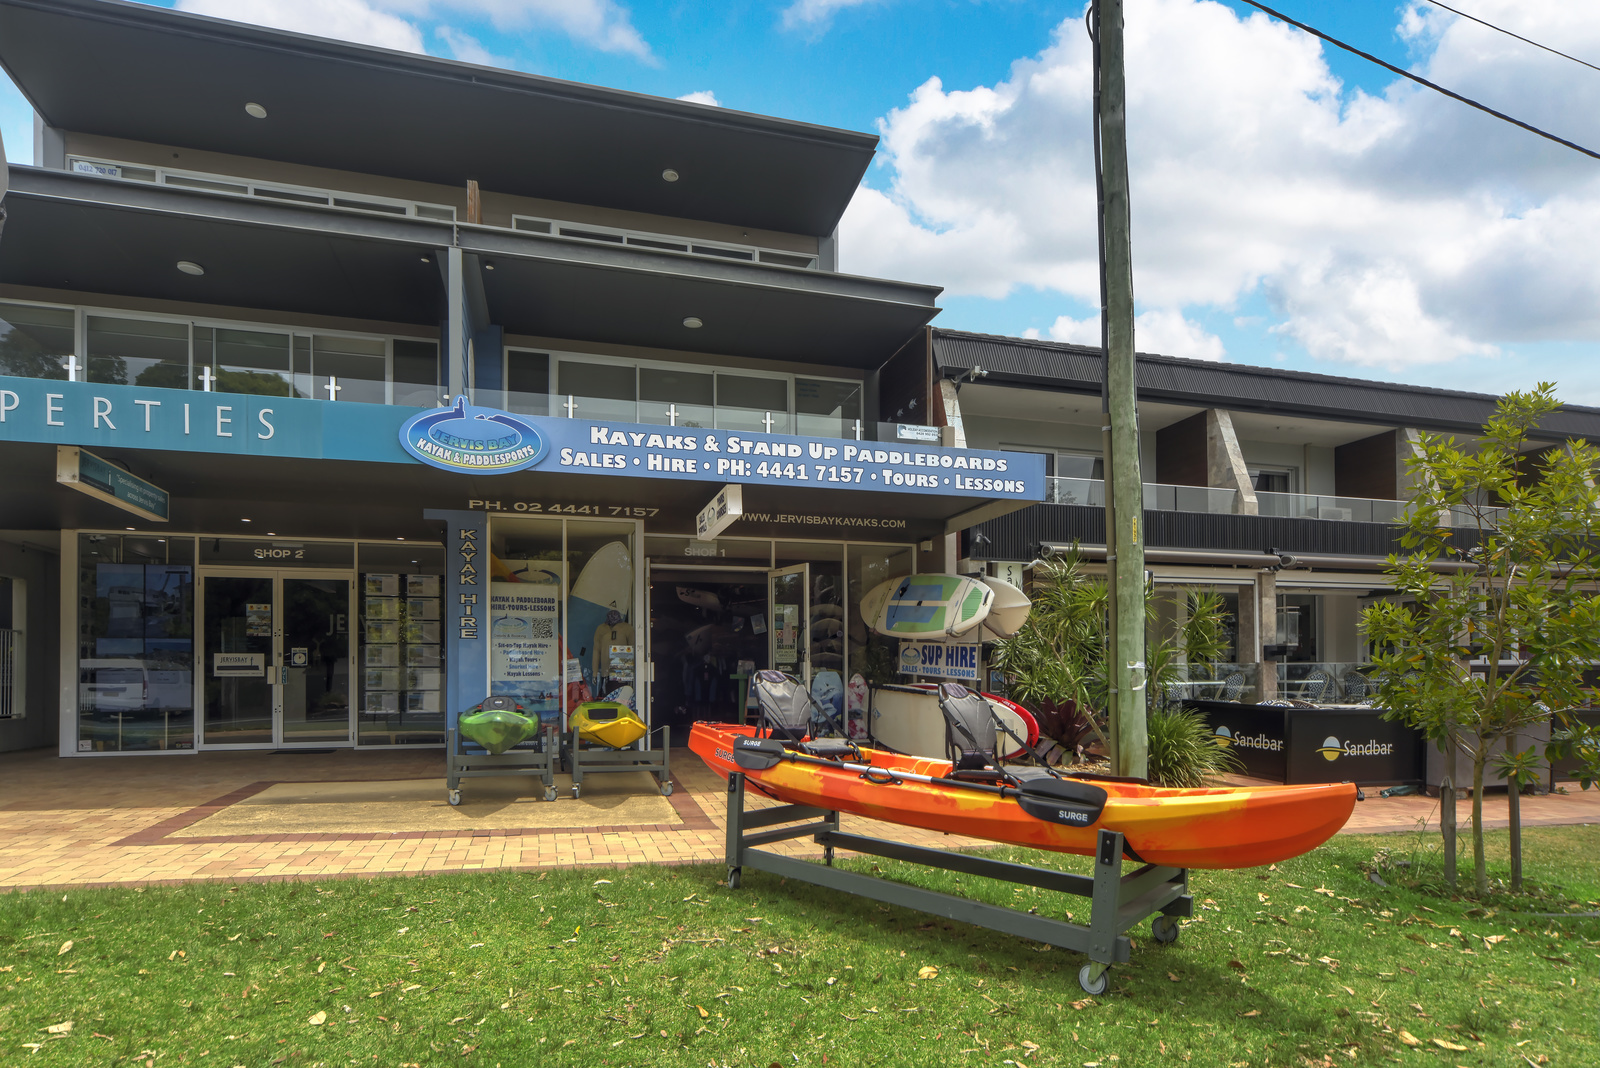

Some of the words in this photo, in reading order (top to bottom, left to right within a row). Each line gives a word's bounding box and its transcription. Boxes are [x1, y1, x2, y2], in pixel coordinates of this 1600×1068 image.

[0, 390, 275, 440] PERTIES
[432, 429, 484, 450] JERVIS
[487, 433, 517, 450] BAY
[590, 426, 698, 451] KAYAKS
[703, 434, 721, 453] &
[726, 436, 803, 458] STAND
[808, 442, 838, 460] UP
[843, 444, 1008, 472] PADDLEBOARDS
[416, 438, 452, 461] KAYAK
[453, 452, 461, 463] &
[463, 445, 535, 466] PADDLESPORTS
[559, 447, 627, 469] SALES
[647, 453, 698, 474] HIRE
[717, 457, 751, 477] PH:
[756, 461, 809, 480] 4441
[815, 465, 864, 483] 7157
[882, 469, 939, 488] TOURS
[955, 474, 1025, 493] LESSONS
[469, 500, 507, 511] PH.
[513, 502, 542, 512] 02
[548, 503, 600, 515] 4441
[608, 506, 660, 517] 7157
[738, 512, 906, 529] WWW.JERVISBAYKAYAKS.COM
[254, 548, 291, 559] SHOP
[295, 549, 304, 559] 2
[459, 529, 478, 585] KAYAK
[684, 547, 717, 557] SHOP
[720, 549, 726, 557] 1
[459, 594, 478, 639] HIRE
[921, 644, 943, 666] SUP
[946, 646, 977, 668] HIRE
[902, 665, 918, 673] SALES
[922, 666, 941, 675] TOURS
[946, 668, 976, 678] LESSONS
[1234, 731, 1283, 751] Sandbar
[1343, 740, 1392, 756] Sandbar
[715, 748, 735, 763] SURGE
[1059, 810, 1088, 822] SURGE
